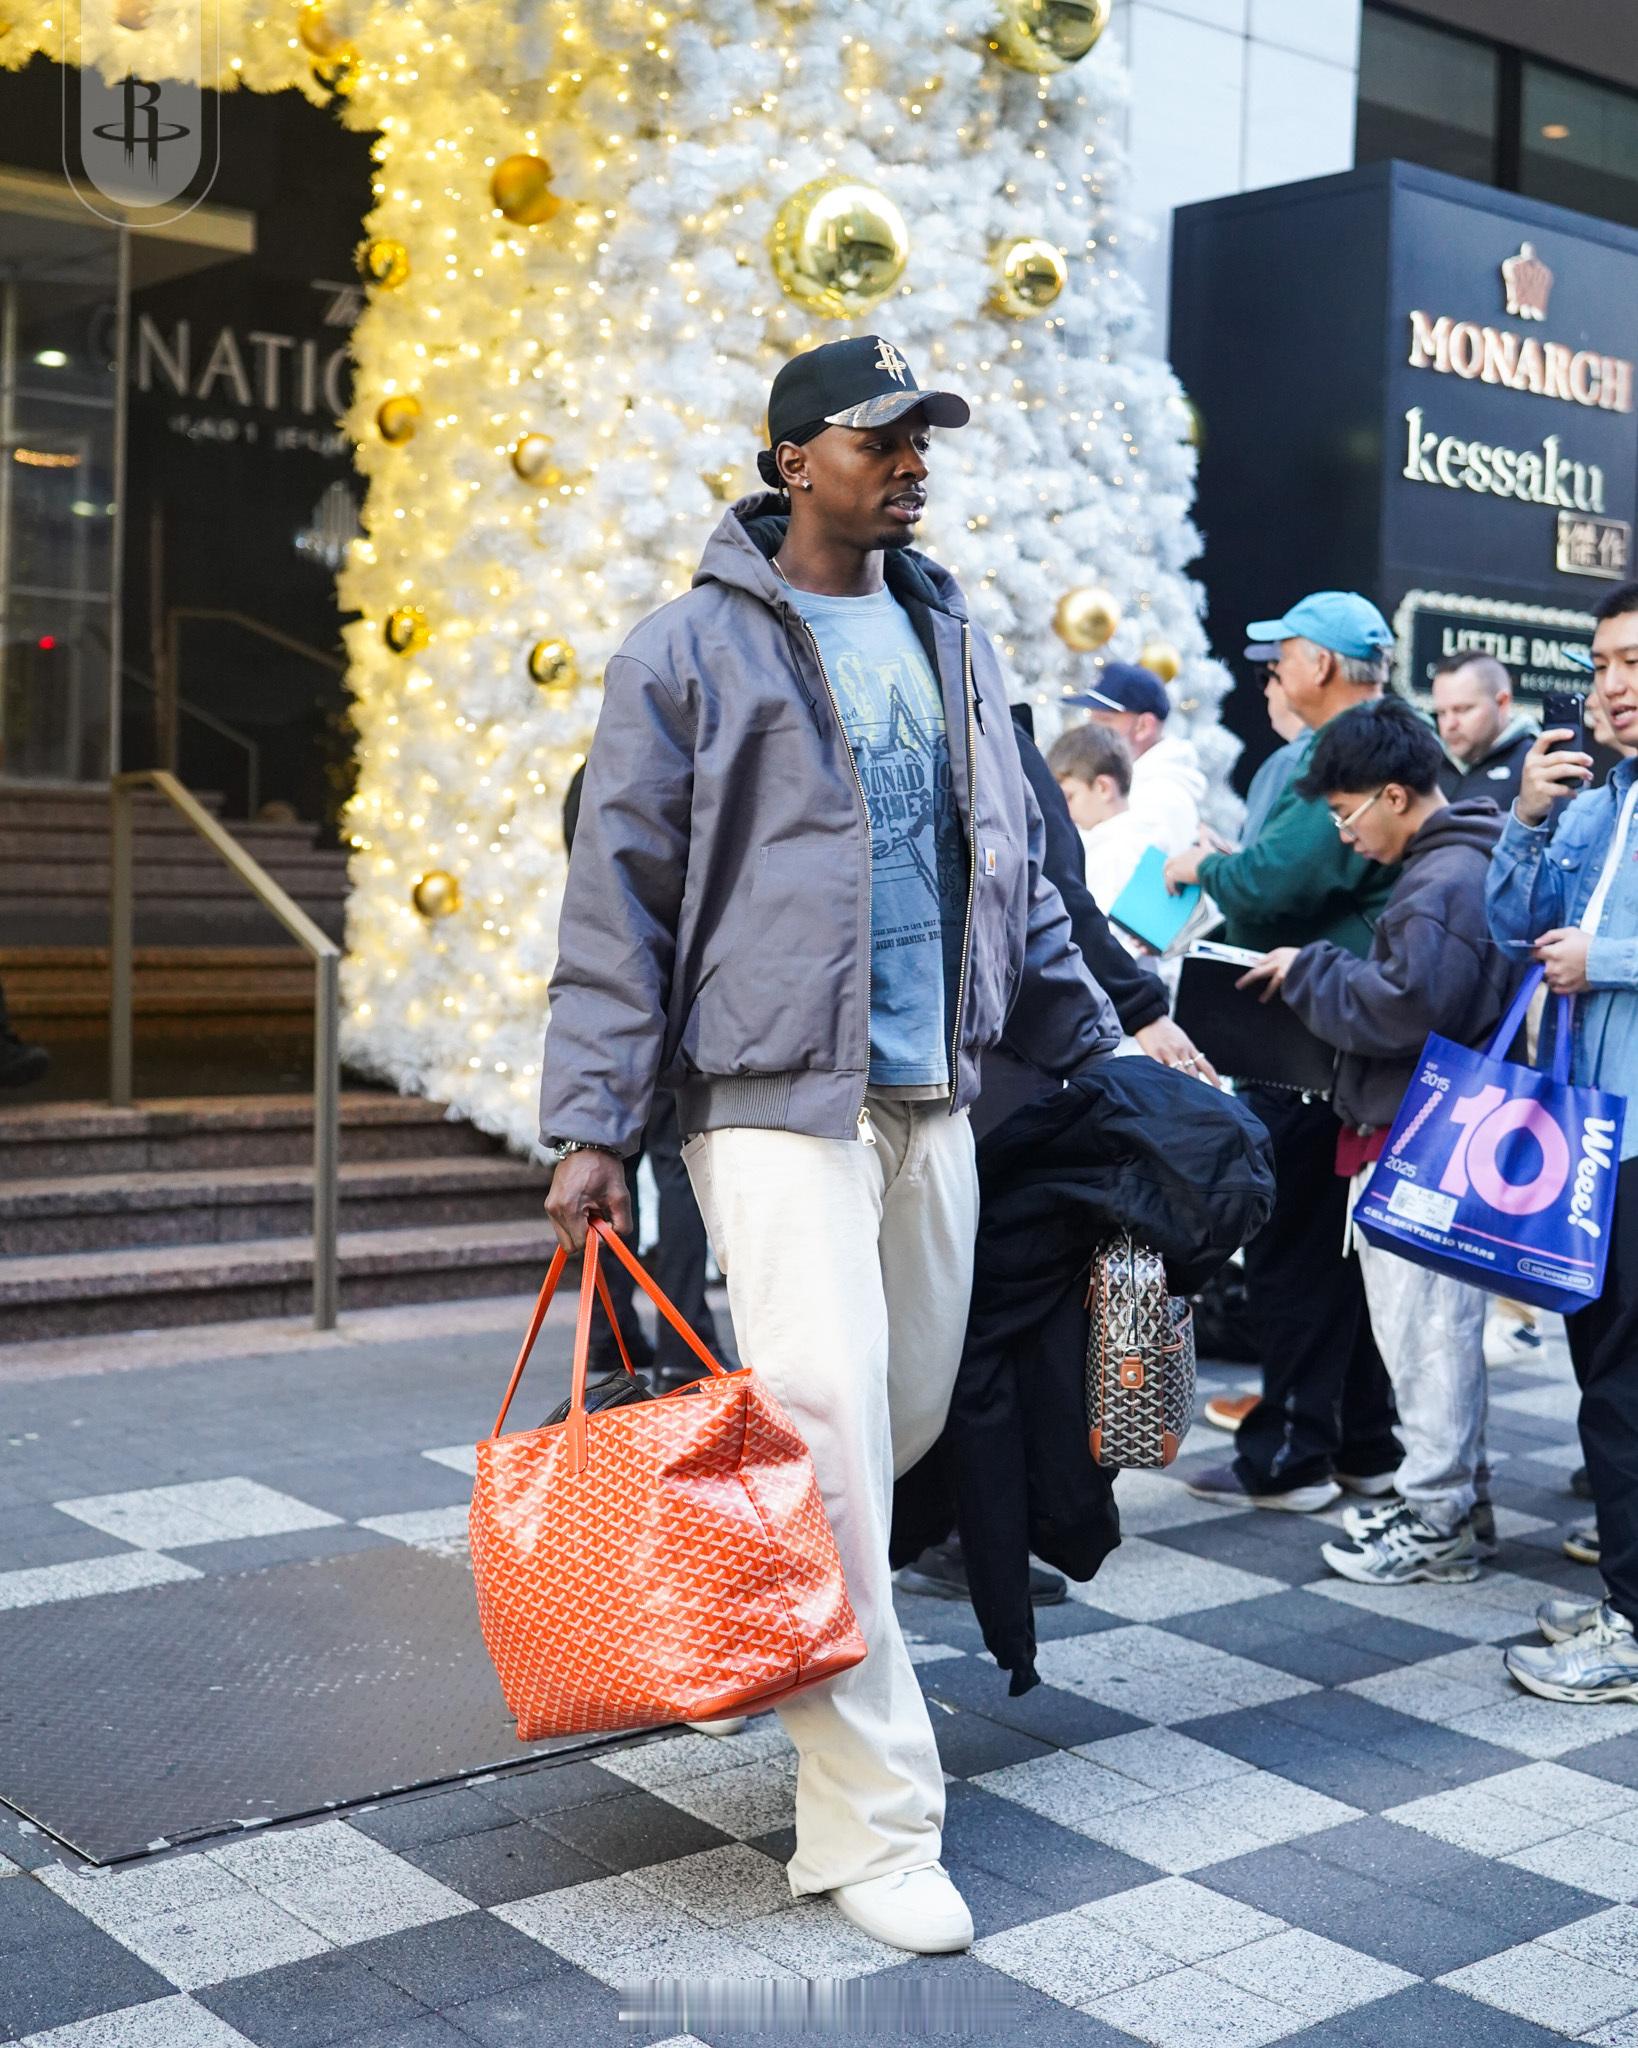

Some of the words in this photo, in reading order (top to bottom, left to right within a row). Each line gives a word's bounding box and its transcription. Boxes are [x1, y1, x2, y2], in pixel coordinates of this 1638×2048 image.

[1408, 310, 1634, 414] MONARCH
[1403, 406, 1605, 513] kessaku
[1442, 626, 1528, 666] LITTLE
[1420, 1069, 1451, 1093] 2015
[1384, 1155, 1417, 1179] 2025
[1438, 1084, 1570, 1216] 10
[1567, 1117, 1616, 1239] Weee!
[1363, 1205, 1442, 1243] CELEBRATING
[1457, 1241, 1497, 1261] YEARS
